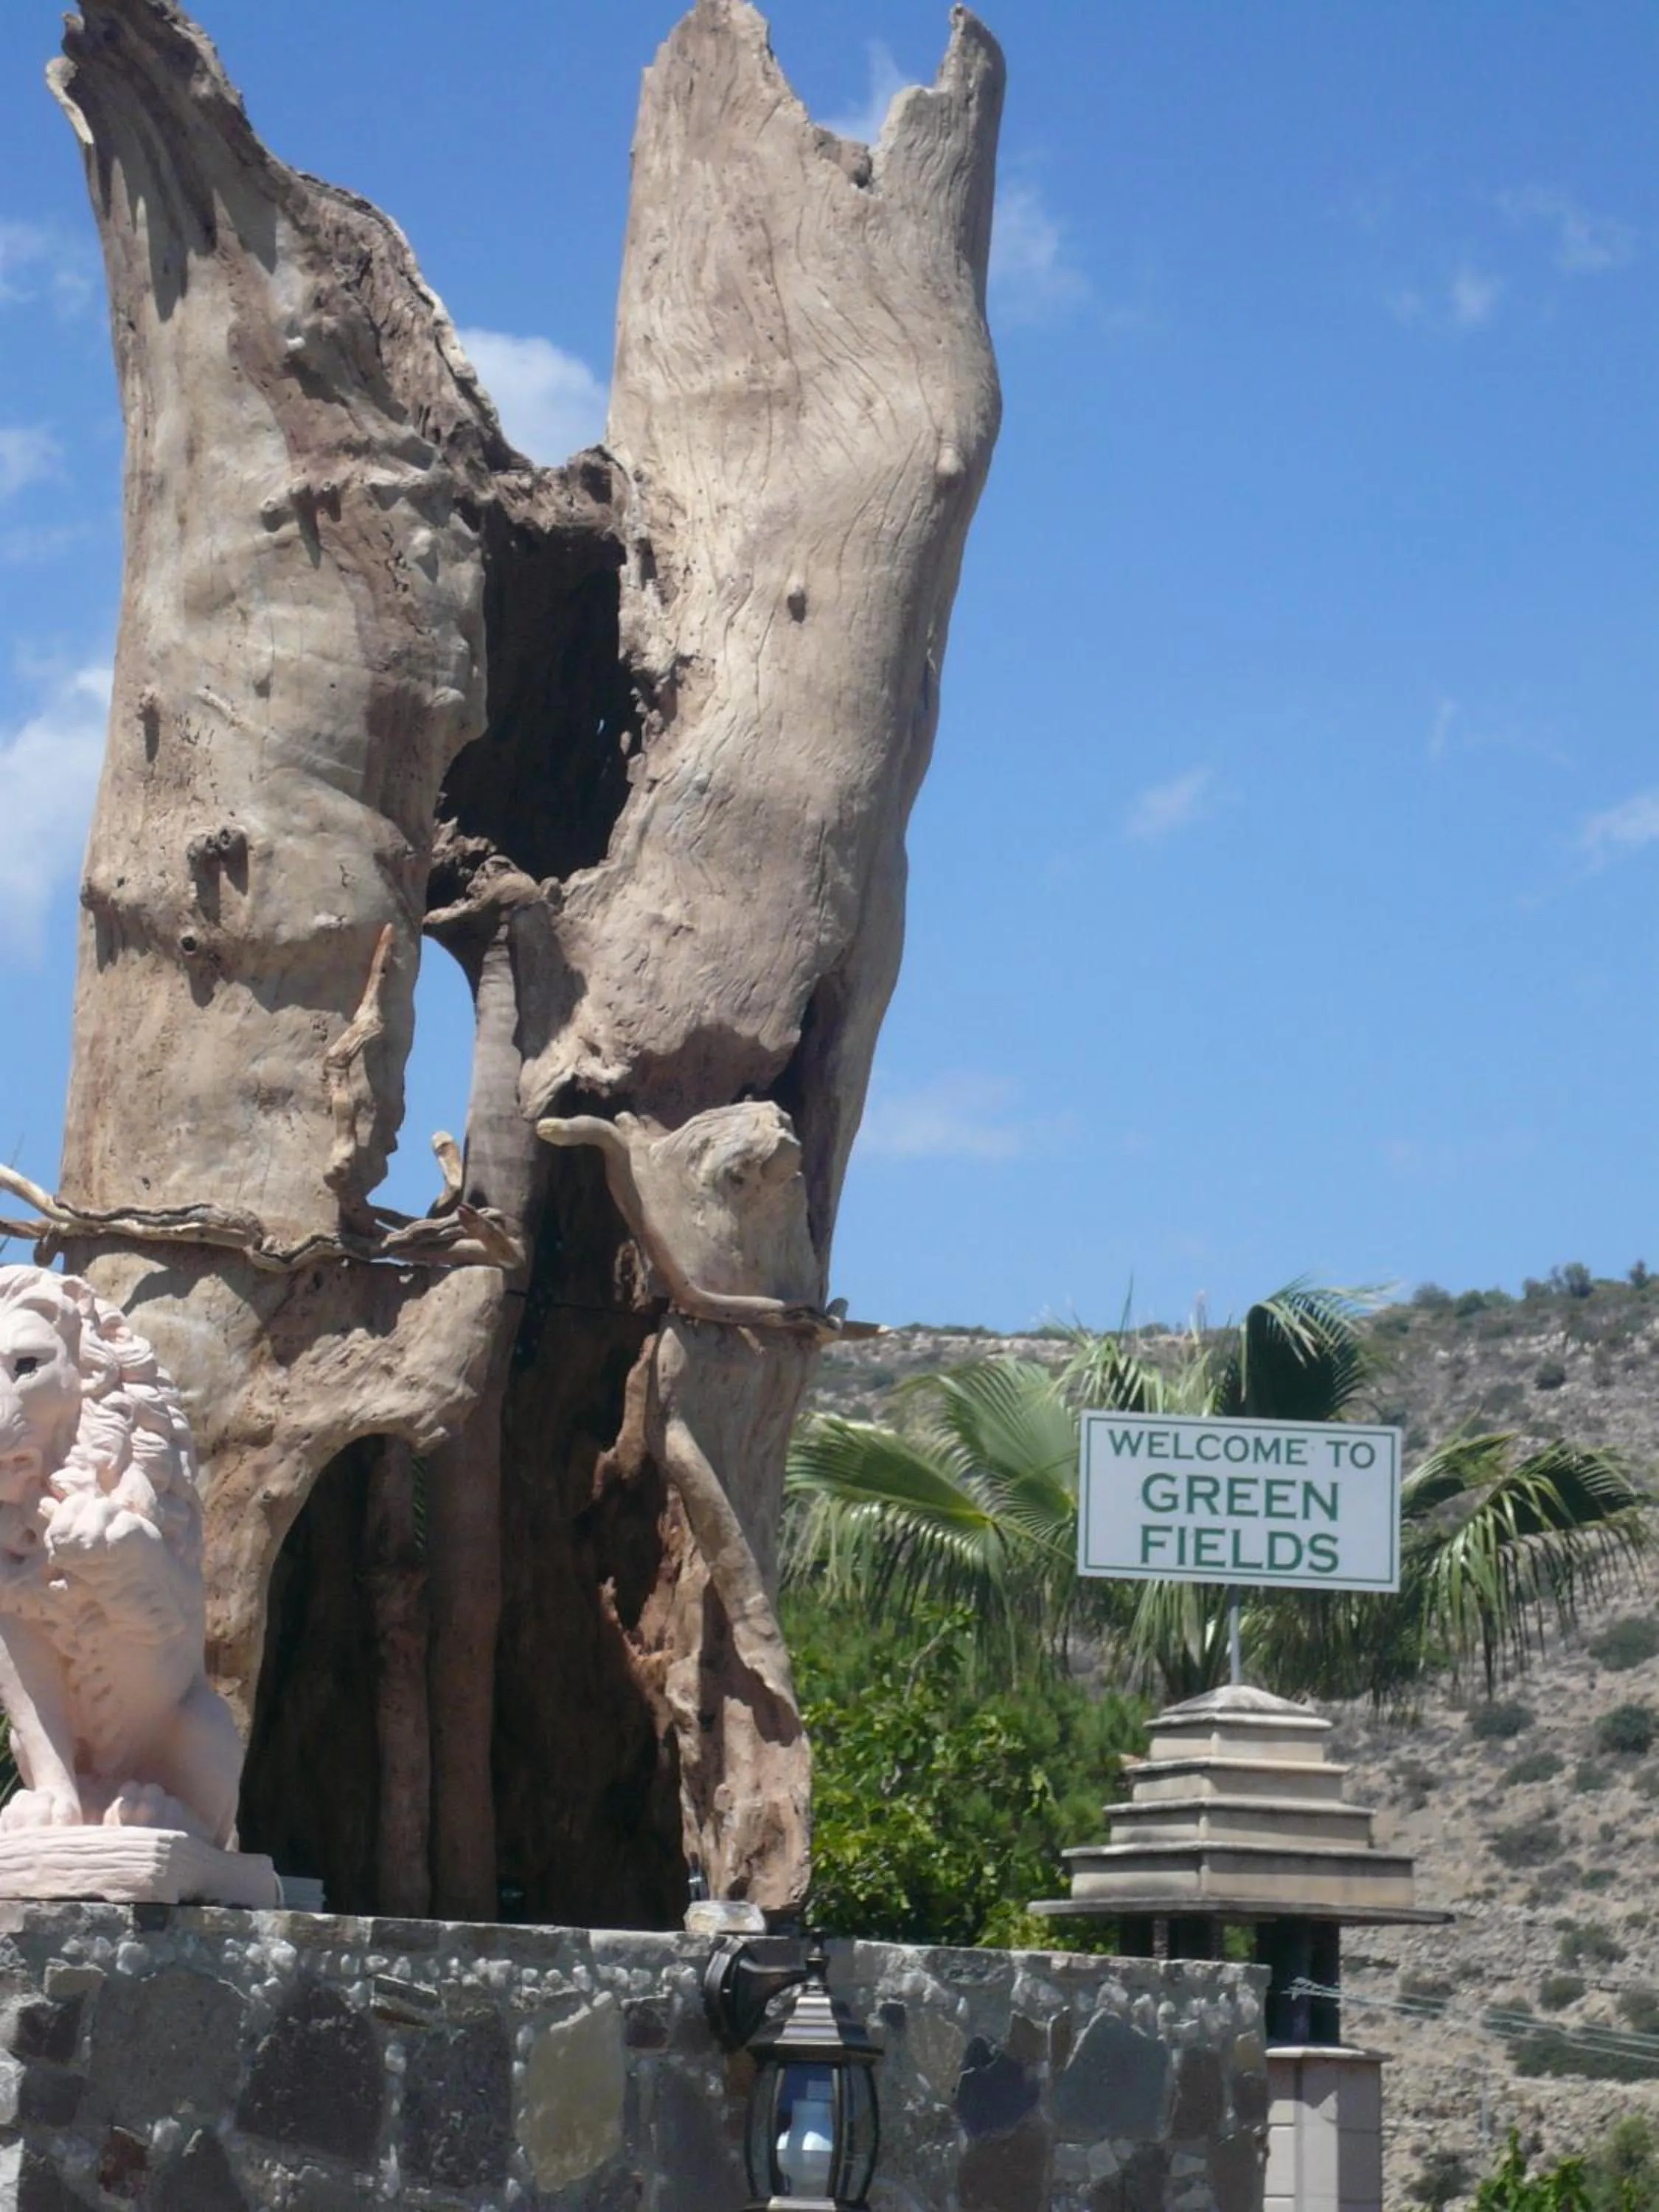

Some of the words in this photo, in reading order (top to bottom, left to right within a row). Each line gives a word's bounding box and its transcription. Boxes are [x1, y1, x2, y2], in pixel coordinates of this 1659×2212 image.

[1107, 1428, 1309, 1467] WELCOME
[1325, 1439, 1377, 1470] TO
[1140, 1472, 1340, 1523] GREEN
[1139, 1523, 1340, 1574] FIELDS
